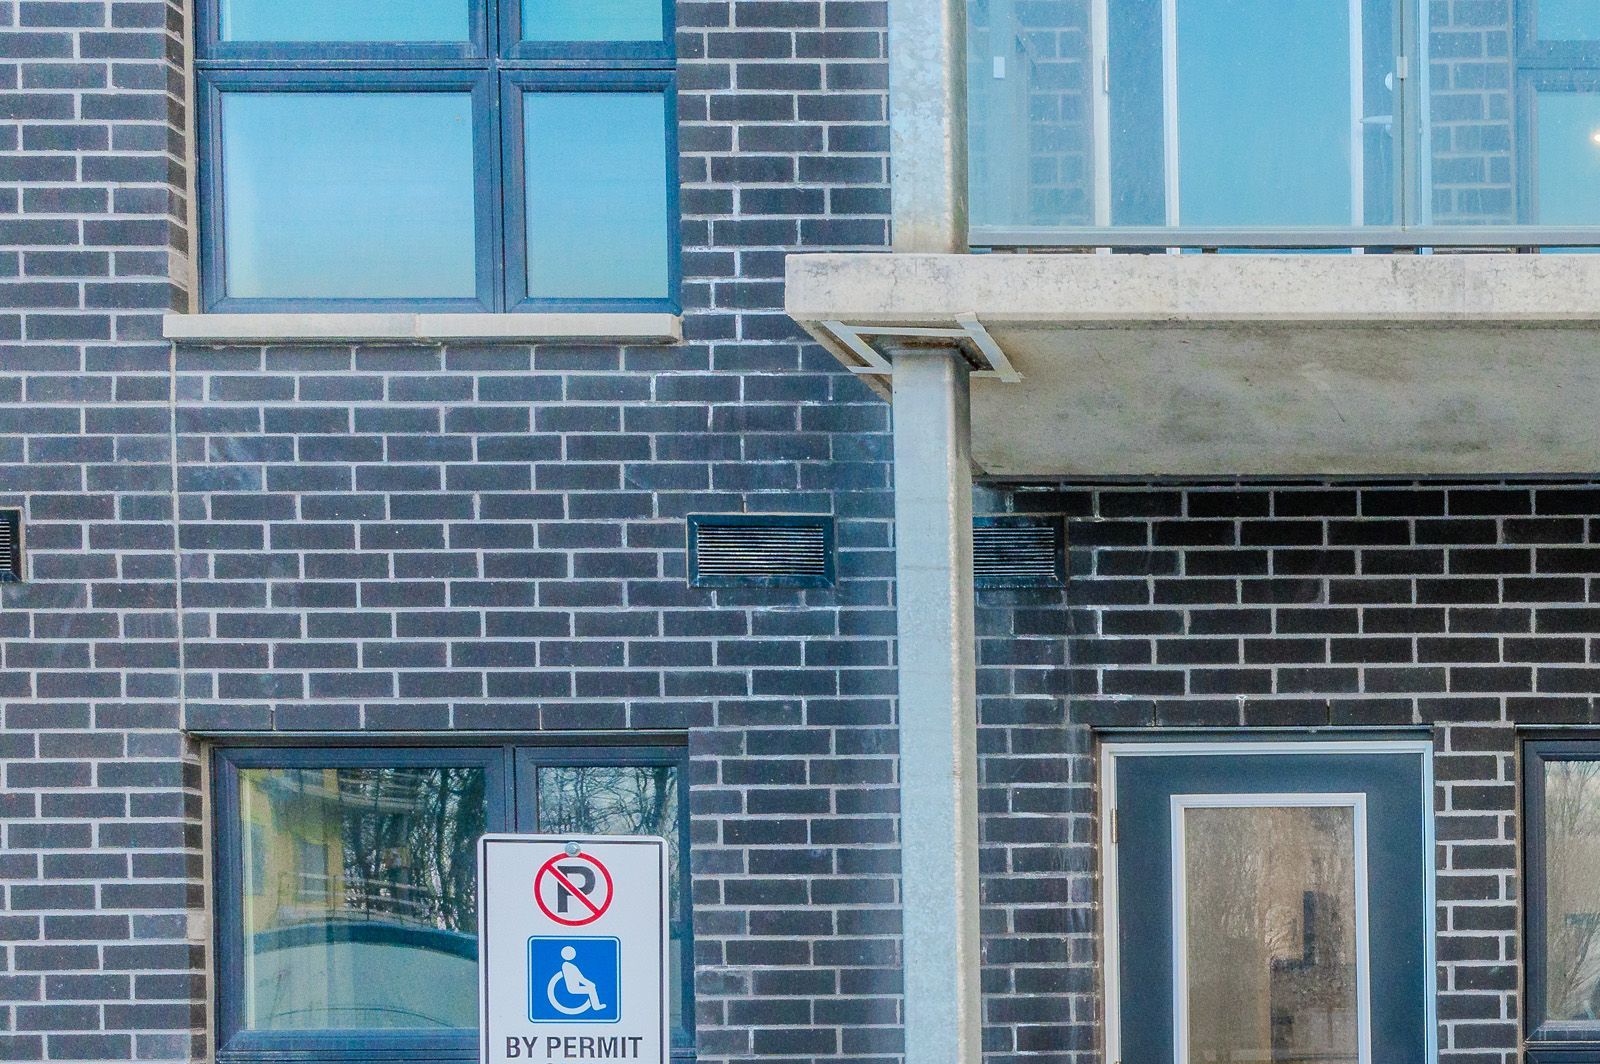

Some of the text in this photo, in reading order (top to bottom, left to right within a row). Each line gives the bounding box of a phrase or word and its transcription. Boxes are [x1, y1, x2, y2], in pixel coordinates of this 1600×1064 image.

[557, 865, 596, 913] P
[506, 1036, 643, 1059] BY PERMIT
